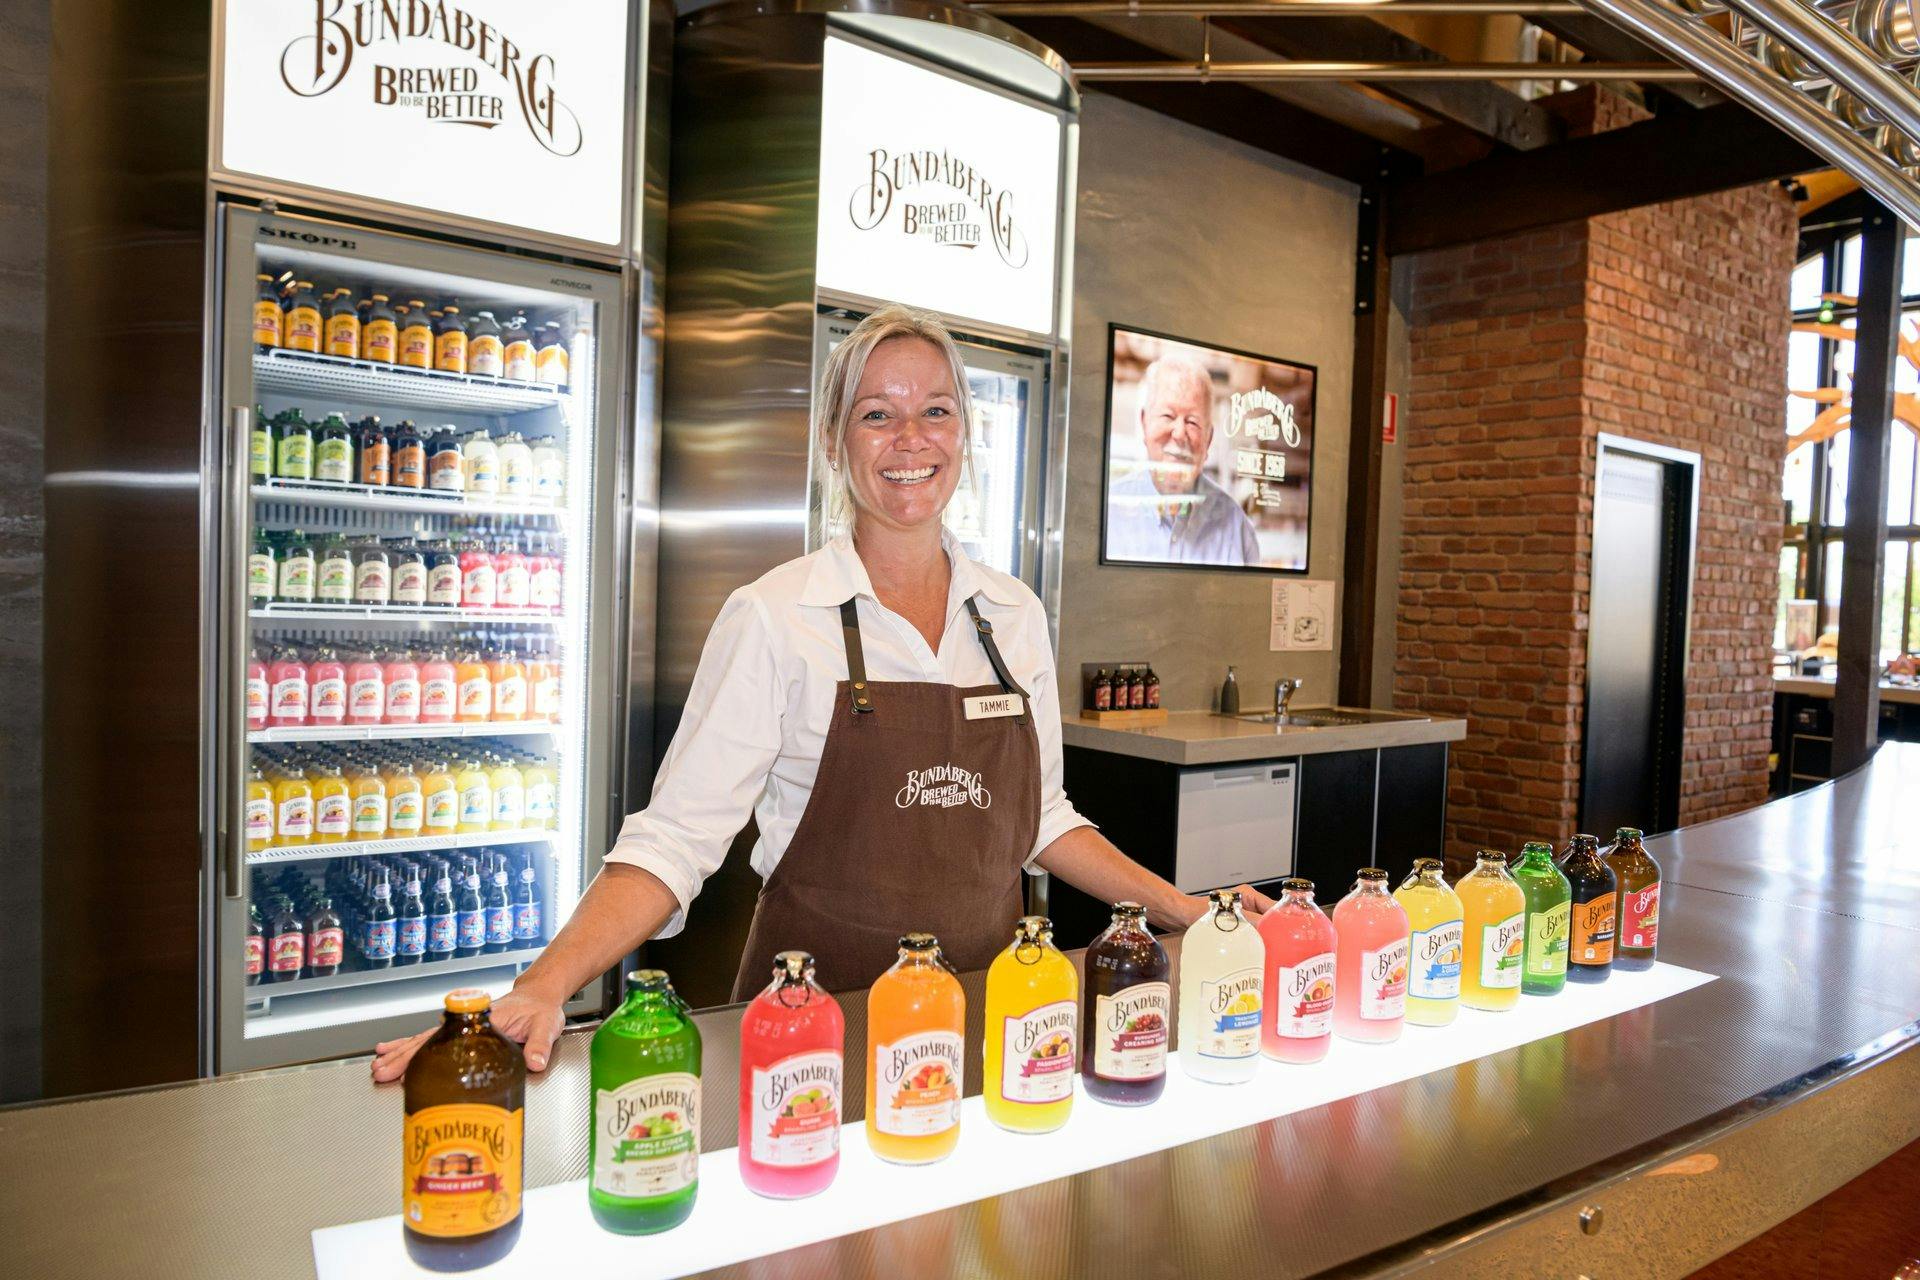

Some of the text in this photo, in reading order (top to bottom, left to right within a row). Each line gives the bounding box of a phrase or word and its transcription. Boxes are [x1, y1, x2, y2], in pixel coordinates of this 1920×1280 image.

[281, 0, 583, 157] BUNDABERG
[374, 64, 478, 106] BREWED
[426, 95, 504, 120] BETTER
[849, 147, 1029, 270] BUNDABERG
[904, 202, 966, 234] BREWED
[935, 223, 981, 243] BETTER
[979, 699, 1010, 714] TAMMIE
[895, 761, 991, 809] BUNDABERG
[920, 783, 959, 805] BREWED
[941, 791, 968, 806] BETTER
[608, 1088, 698, 1138] BUNDABERG
[408, 1120, 514, 1165] BUNDABERG
[459, 1179, 485, 1190] BEER
